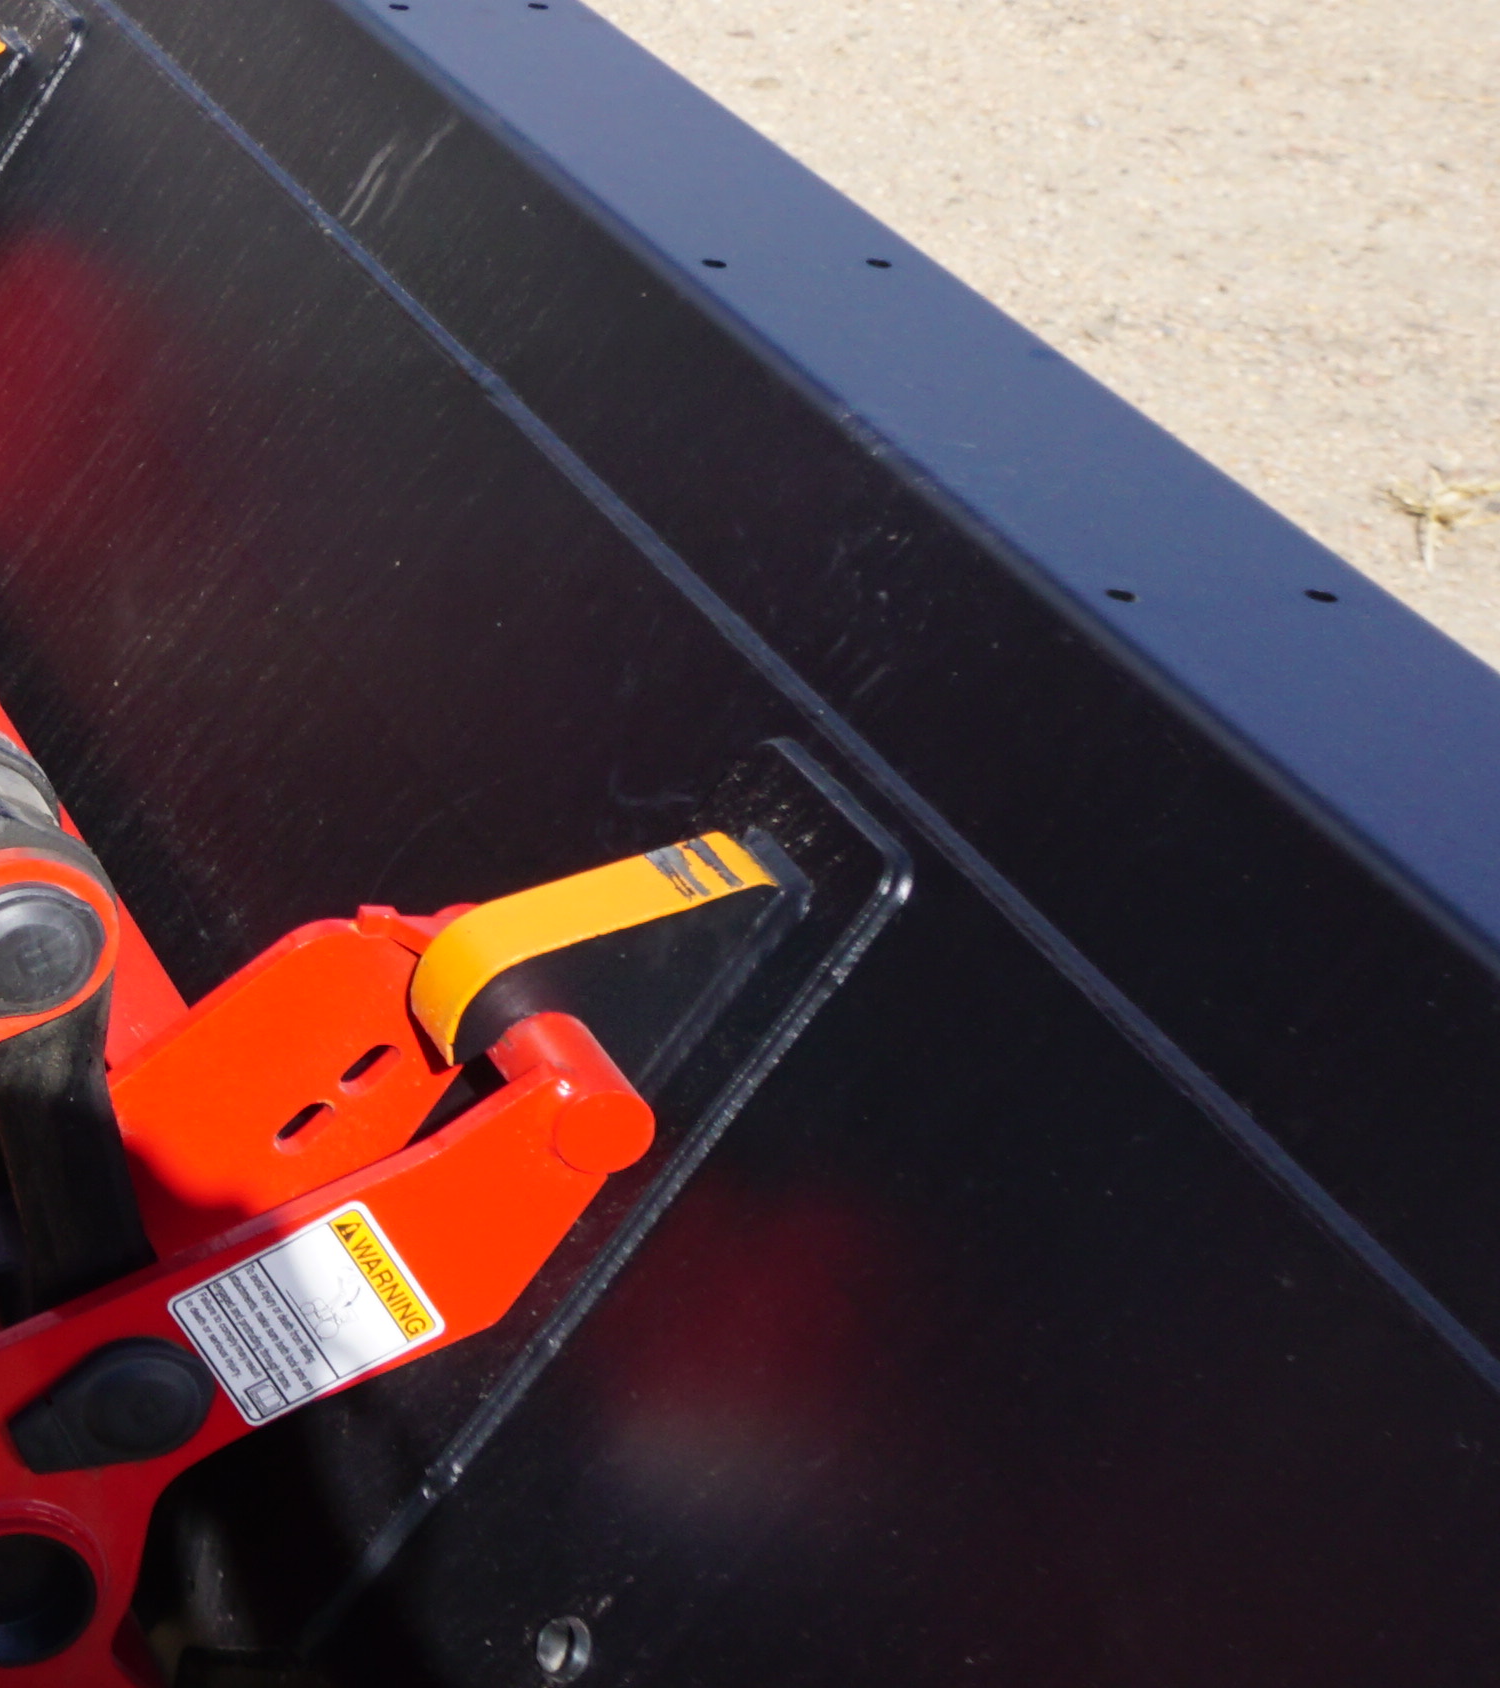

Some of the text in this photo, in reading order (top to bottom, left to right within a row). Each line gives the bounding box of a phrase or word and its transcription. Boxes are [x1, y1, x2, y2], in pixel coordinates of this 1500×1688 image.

[249, 1272, 267, 1292] avoid
[260, 1288, 277, 1308] injury
[276, 1313, 294, 1331] death
[288, 1328, 304, 1346] from
[298, 1342, 316, 1365] falling
[351, 1236, 426, 1336] WARNING
[188, 1306, 207, 1326] death
[207, 1332, 229, 1359] serious
[197, 1290, 217, 1316] Failure
[217, 1321, 239, 1347] comply
[234, 1343, 248, 1361] may
[243, 1357, 263, 1379] result
[229, 1306, 245, 1321] and
[256, 1346, 280, 1375] through
[254, 1310, 271, 1329] make
[265, 1326, 279, 1342] sure
[273, 1339, 290, 1355] both
